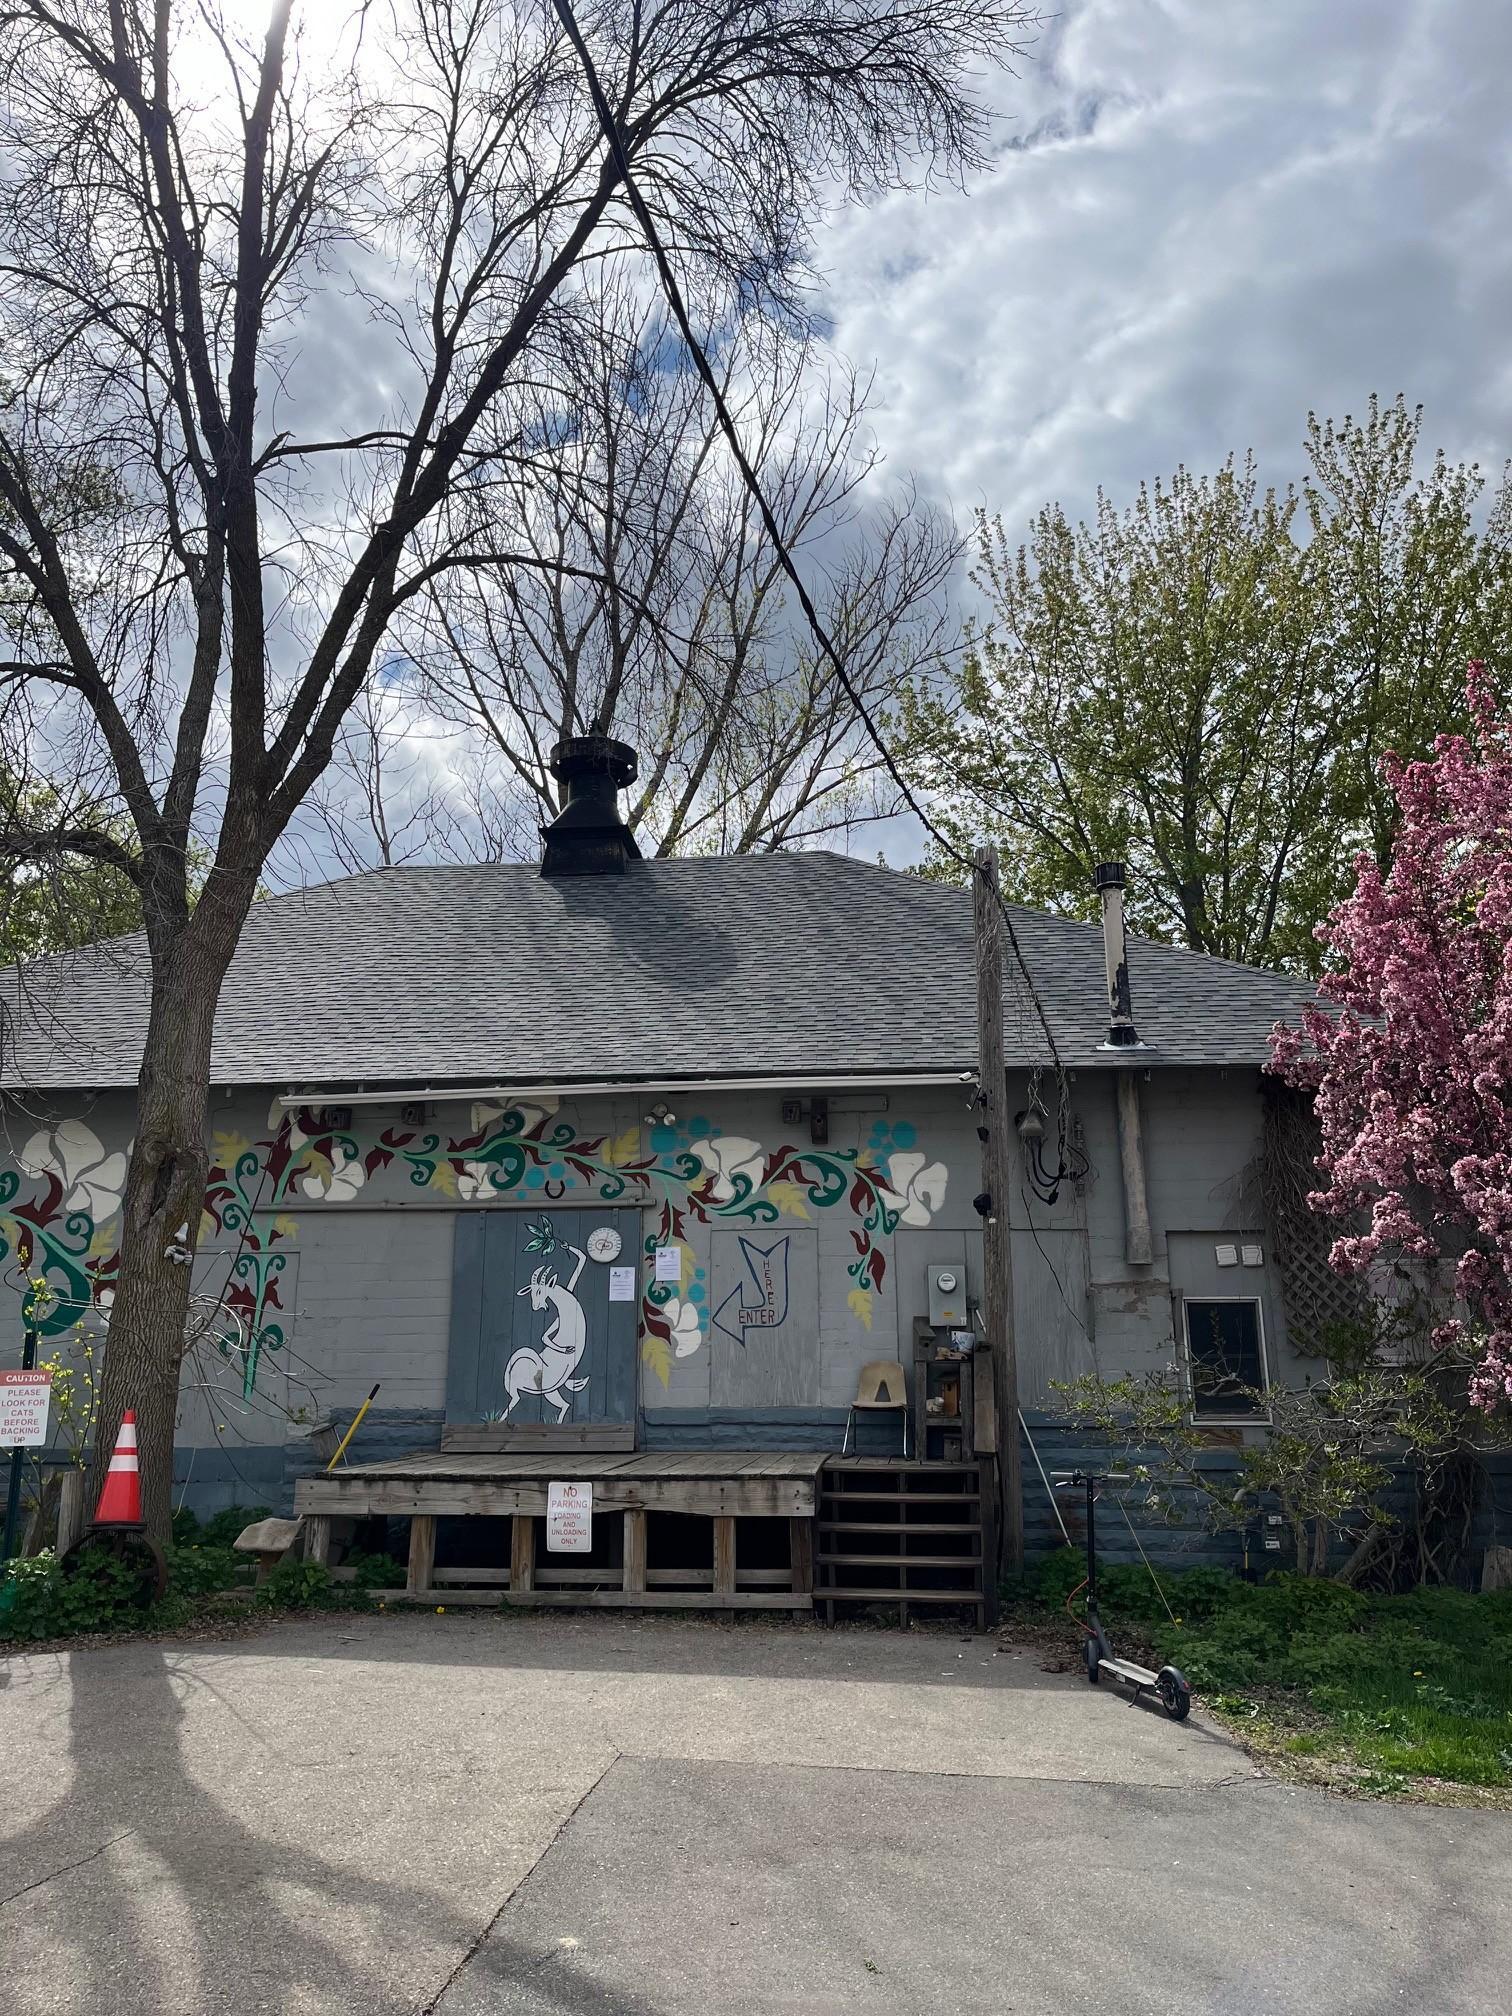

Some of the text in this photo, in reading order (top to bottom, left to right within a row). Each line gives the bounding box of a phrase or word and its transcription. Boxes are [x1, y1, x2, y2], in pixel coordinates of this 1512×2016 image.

[763, 1259, 774, 1305] HERE
[738, 1309, 775, 1324] ENTER
[6, 1374, 46, 1383] CAUTION
[11, 1409, 34, 1417] CATS
[1, 1427, 40, 1435] BACKING
[13, 1436, 25, 1444] UP
[563, 1487, 578, 1498] NO
[551, 1500, 588, 1508] PARKING
[553, 1512, 581, 1520] LOADING
